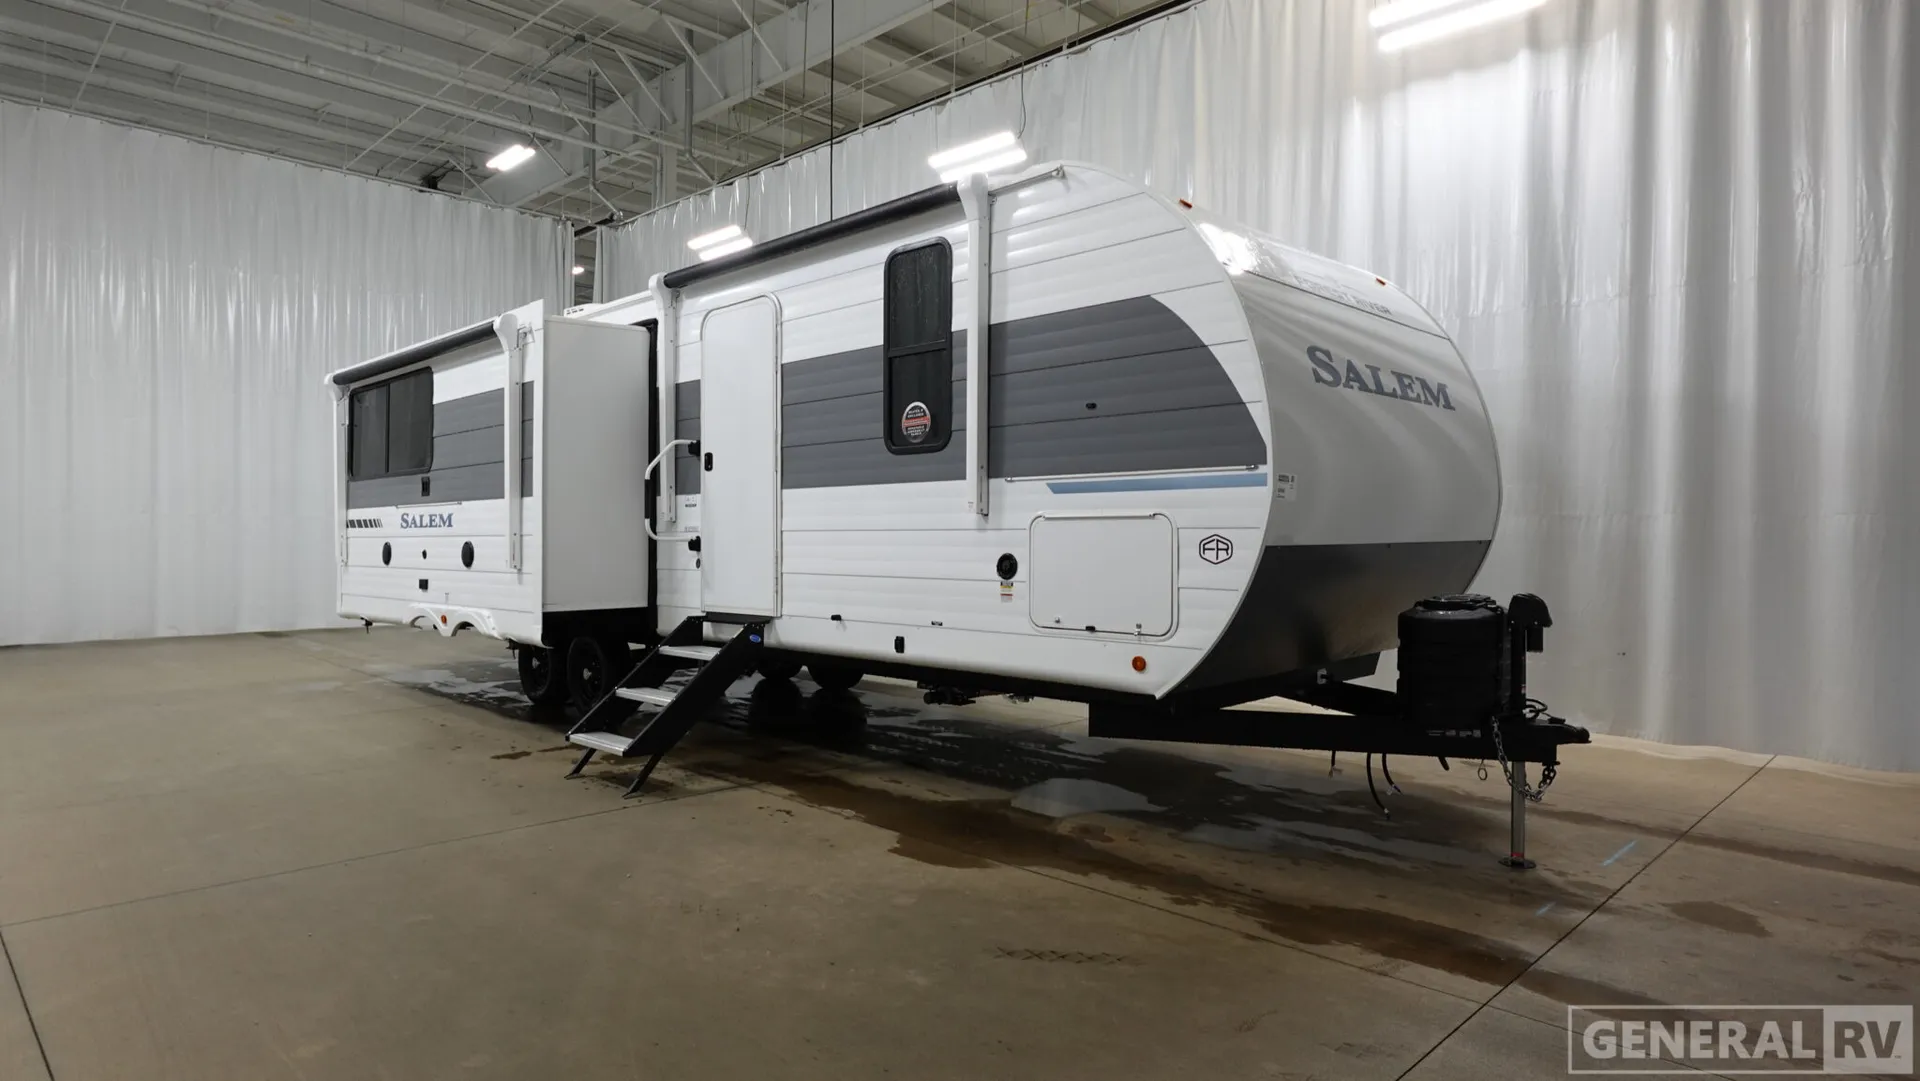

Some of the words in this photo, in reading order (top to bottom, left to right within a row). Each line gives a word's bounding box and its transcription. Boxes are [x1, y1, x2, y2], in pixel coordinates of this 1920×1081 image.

[1354, 296, 1393, 316] RIVER
[1306, 345, 1456, 411] SALEM
[400, 512, 454, 529] SALEM
